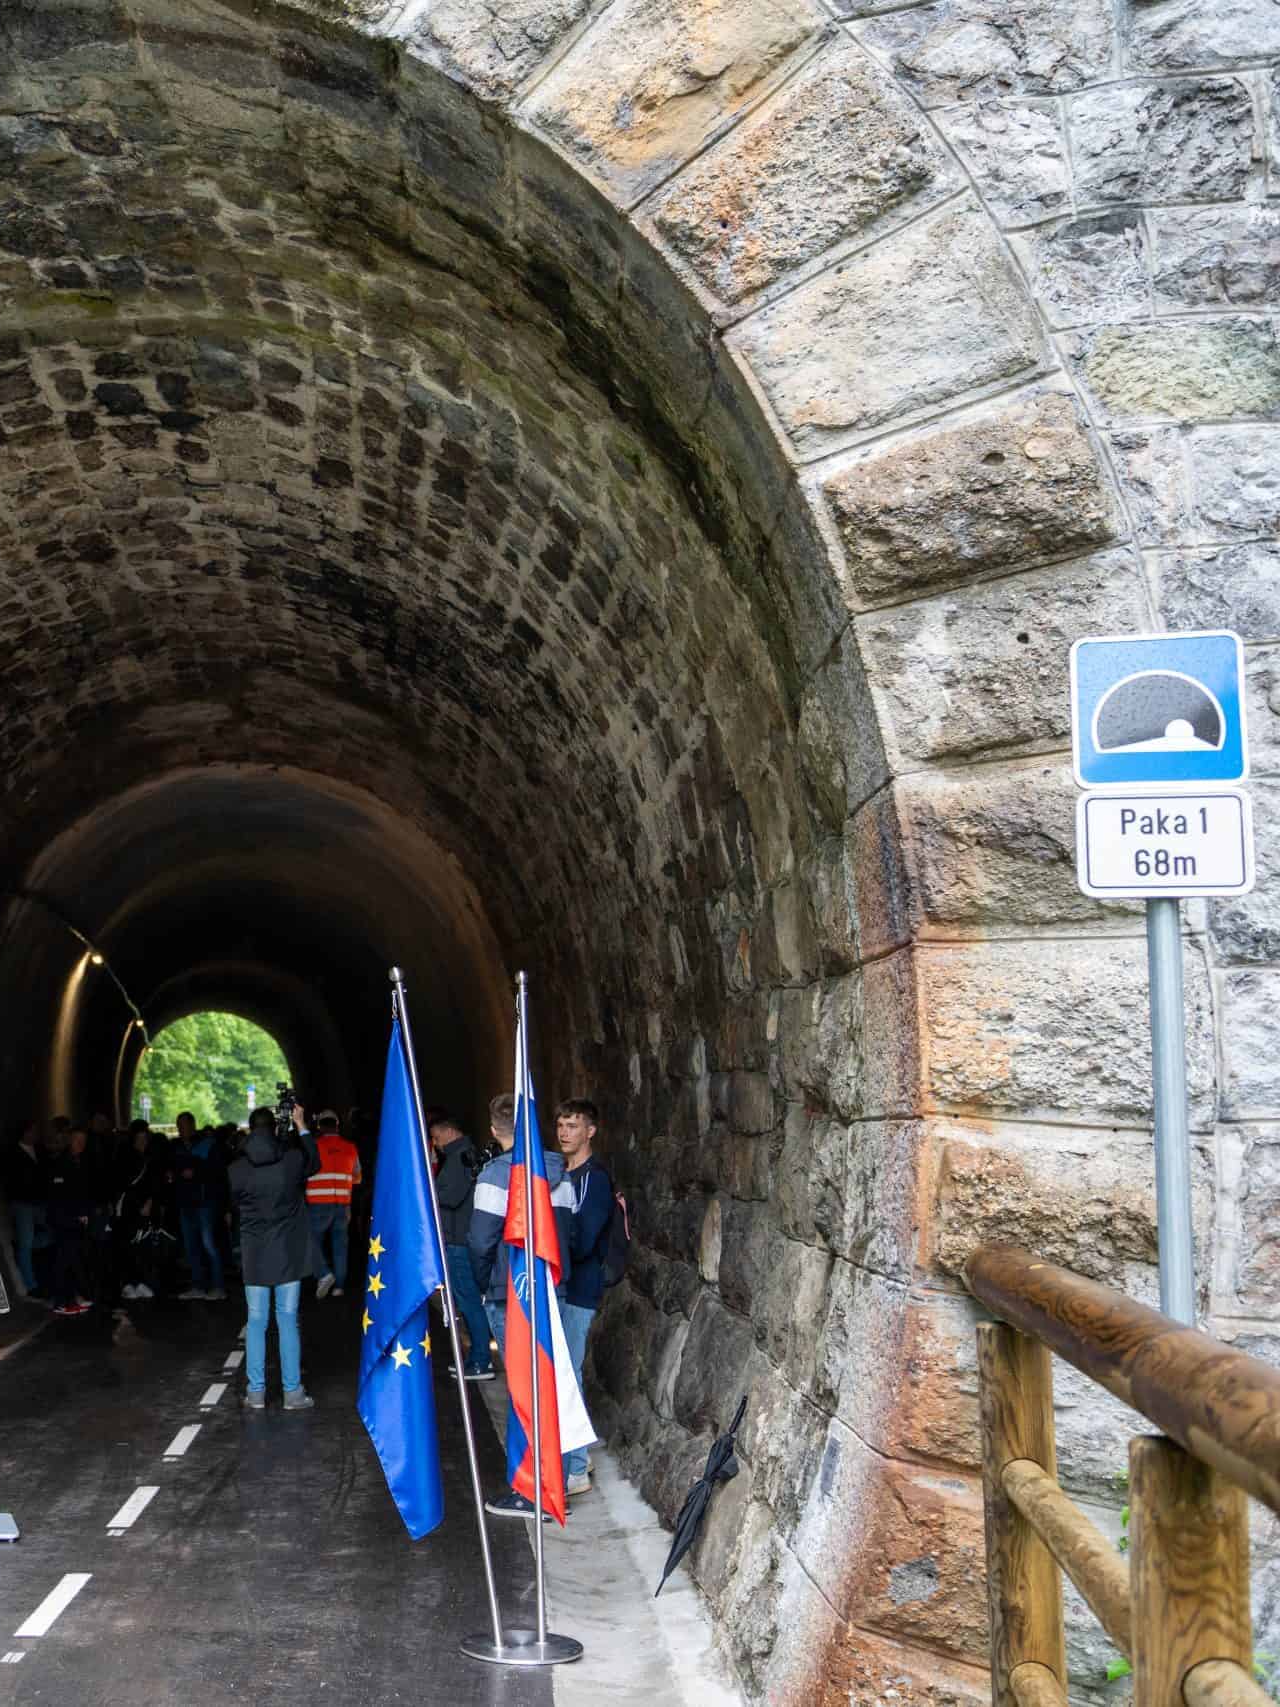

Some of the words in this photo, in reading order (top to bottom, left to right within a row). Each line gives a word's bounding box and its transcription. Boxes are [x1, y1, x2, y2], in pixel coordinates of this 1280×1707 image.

[1120, 808, 1188, 835] Paka
[1199, 807, 1208, 834] 1
[1134, 849, 1197, 877] 68m
